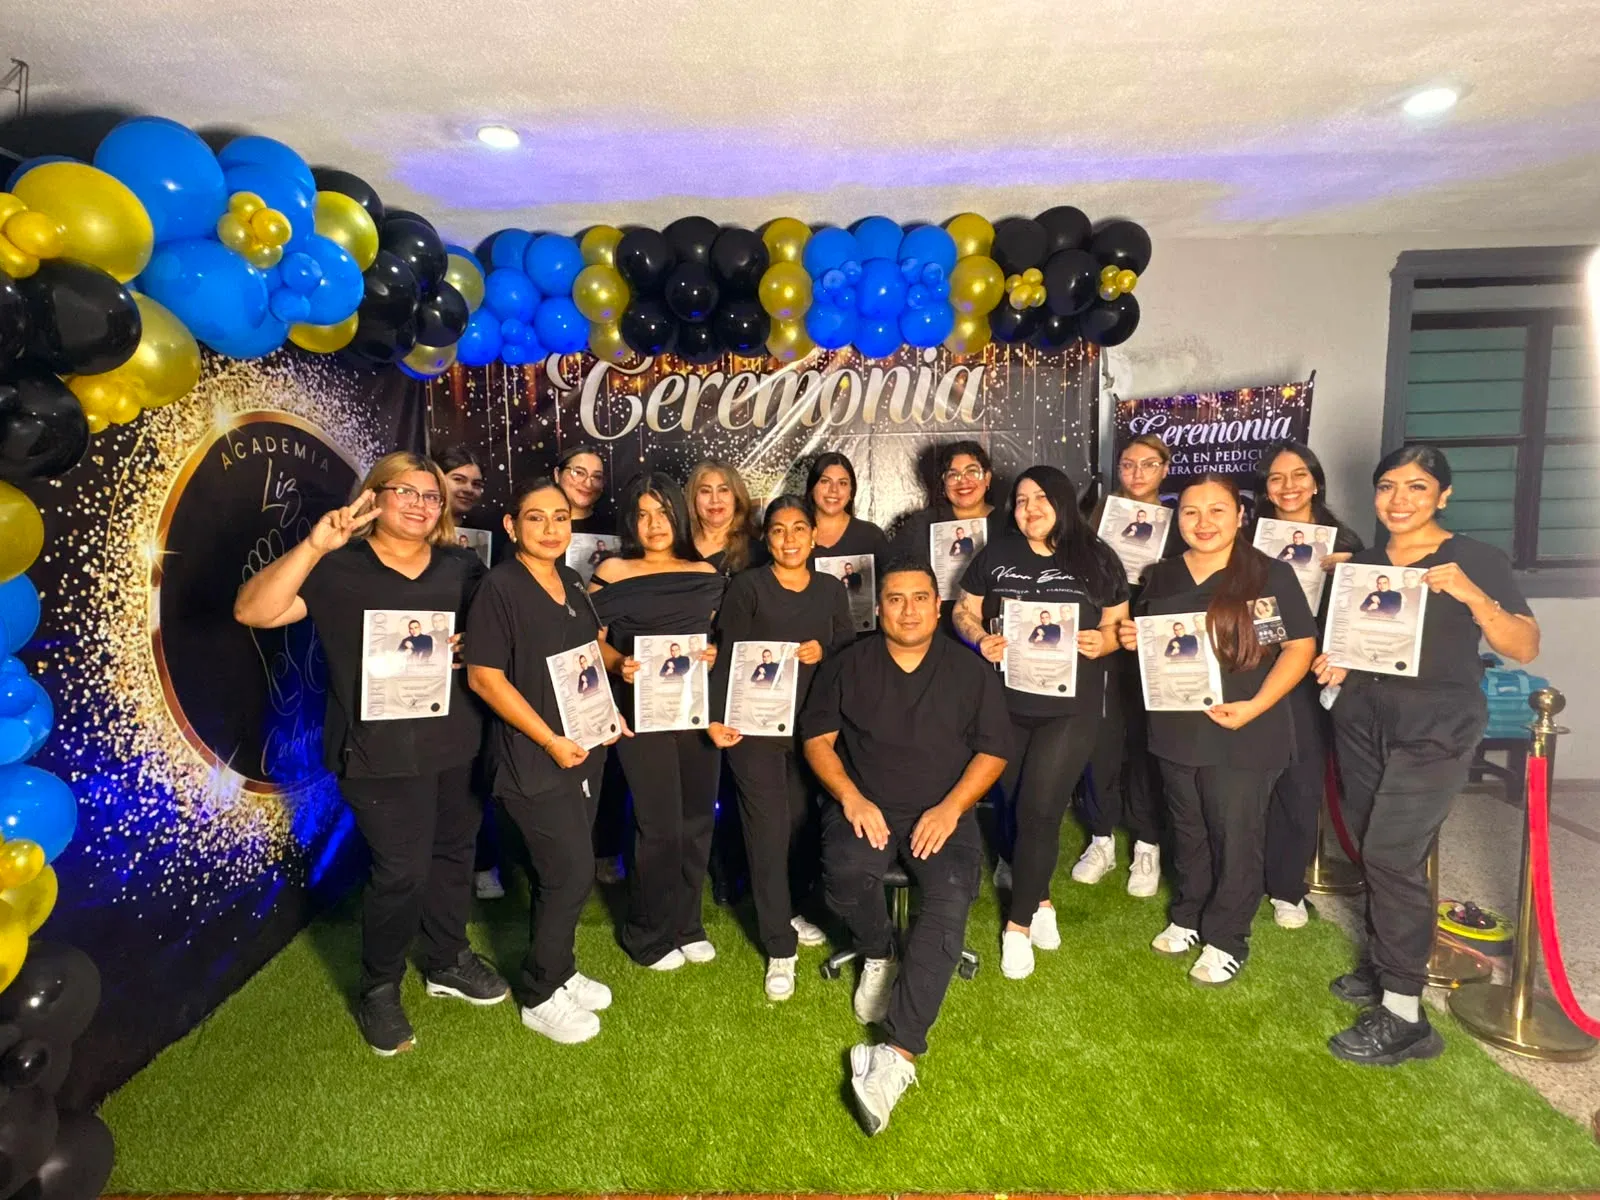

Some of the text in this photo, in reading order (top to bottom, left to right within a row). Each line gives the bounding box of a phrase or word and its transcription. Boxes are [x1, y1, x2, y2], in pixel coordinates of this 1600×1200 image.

[546, 346, 987, 440] Ceremonia
[221, 436, 329, 472] ACADEMIA
[1129, 414, 1292, 448] Ceremonia
[1193, 452, 1210, 463] EN
[261, 457, 301, 528] Liz
[369, 612, 387, 717] CERTADO
